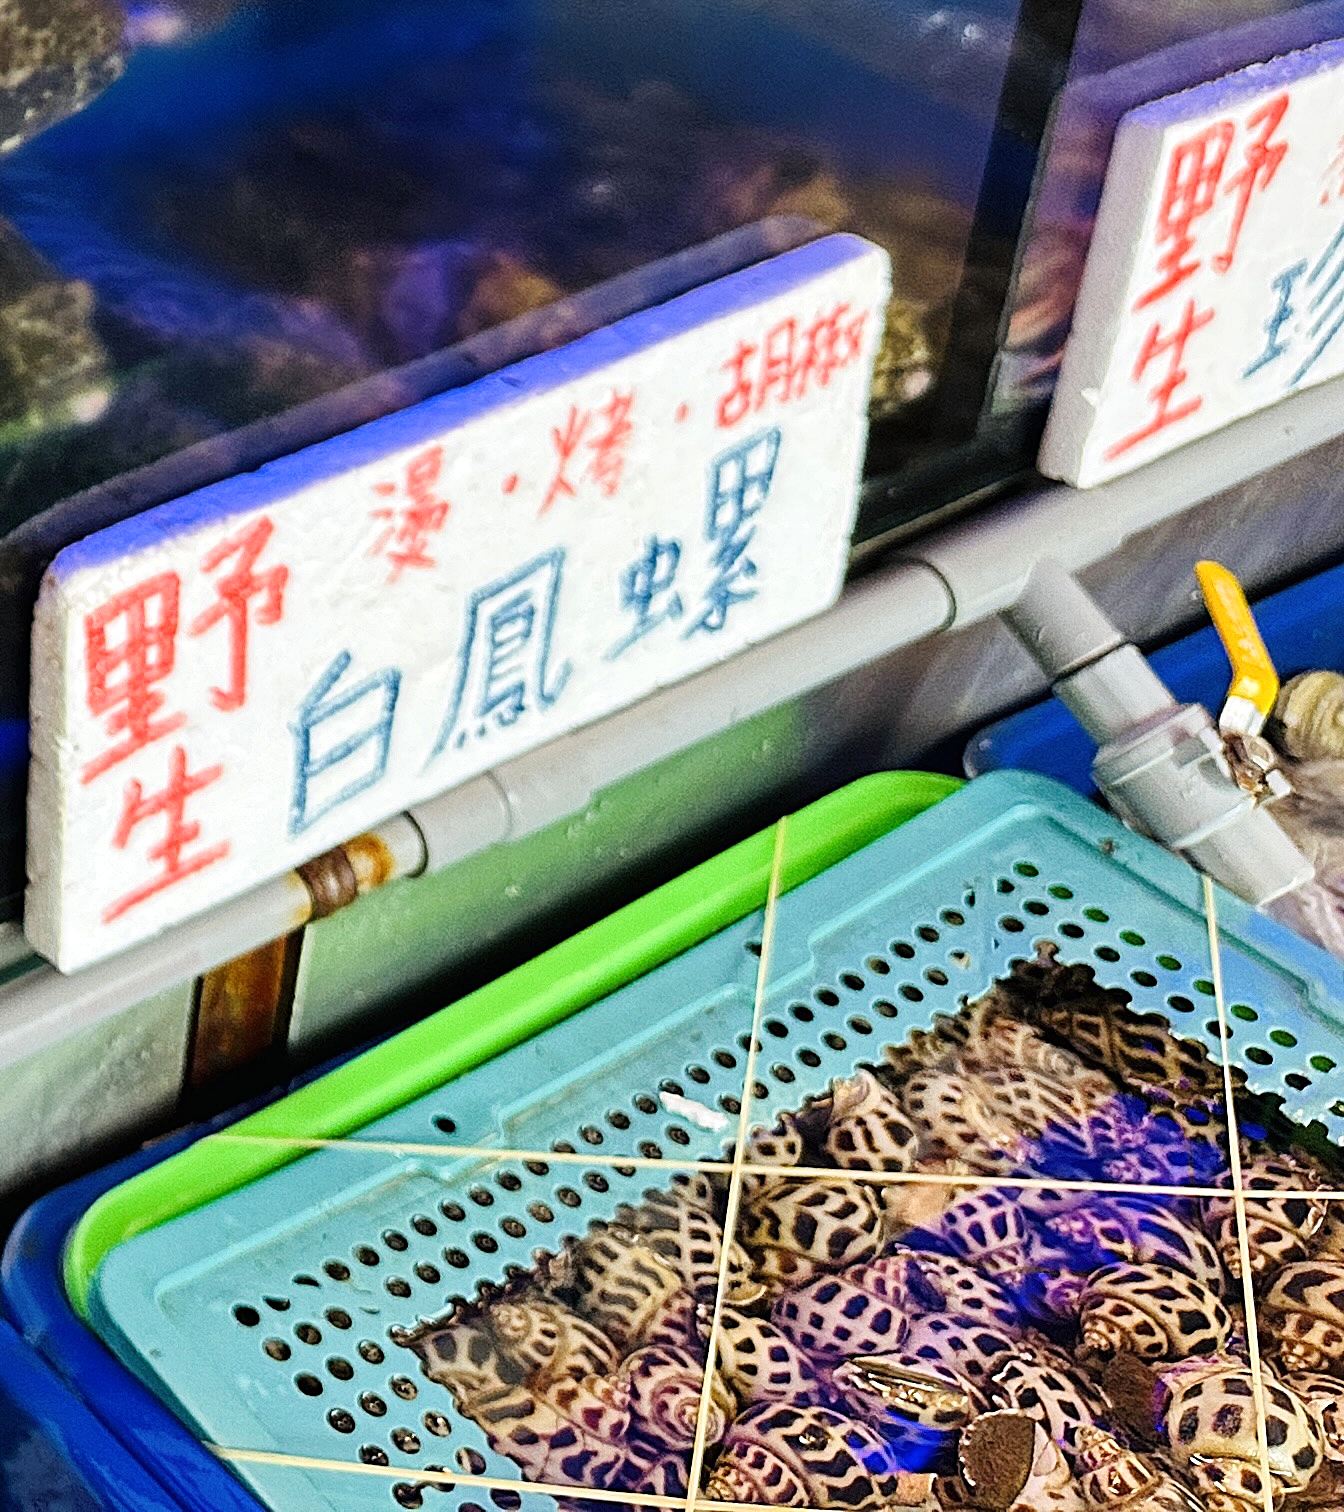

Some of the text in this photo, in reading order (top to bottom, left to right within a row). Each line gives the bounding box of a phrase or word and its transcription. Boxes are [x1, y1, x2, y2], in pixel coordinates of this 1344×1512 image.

[1103, 92, 1290, 462] 野生
[81, 516, 291, 924] 野生
[286, 427, 782, 837] 白鳳螺
